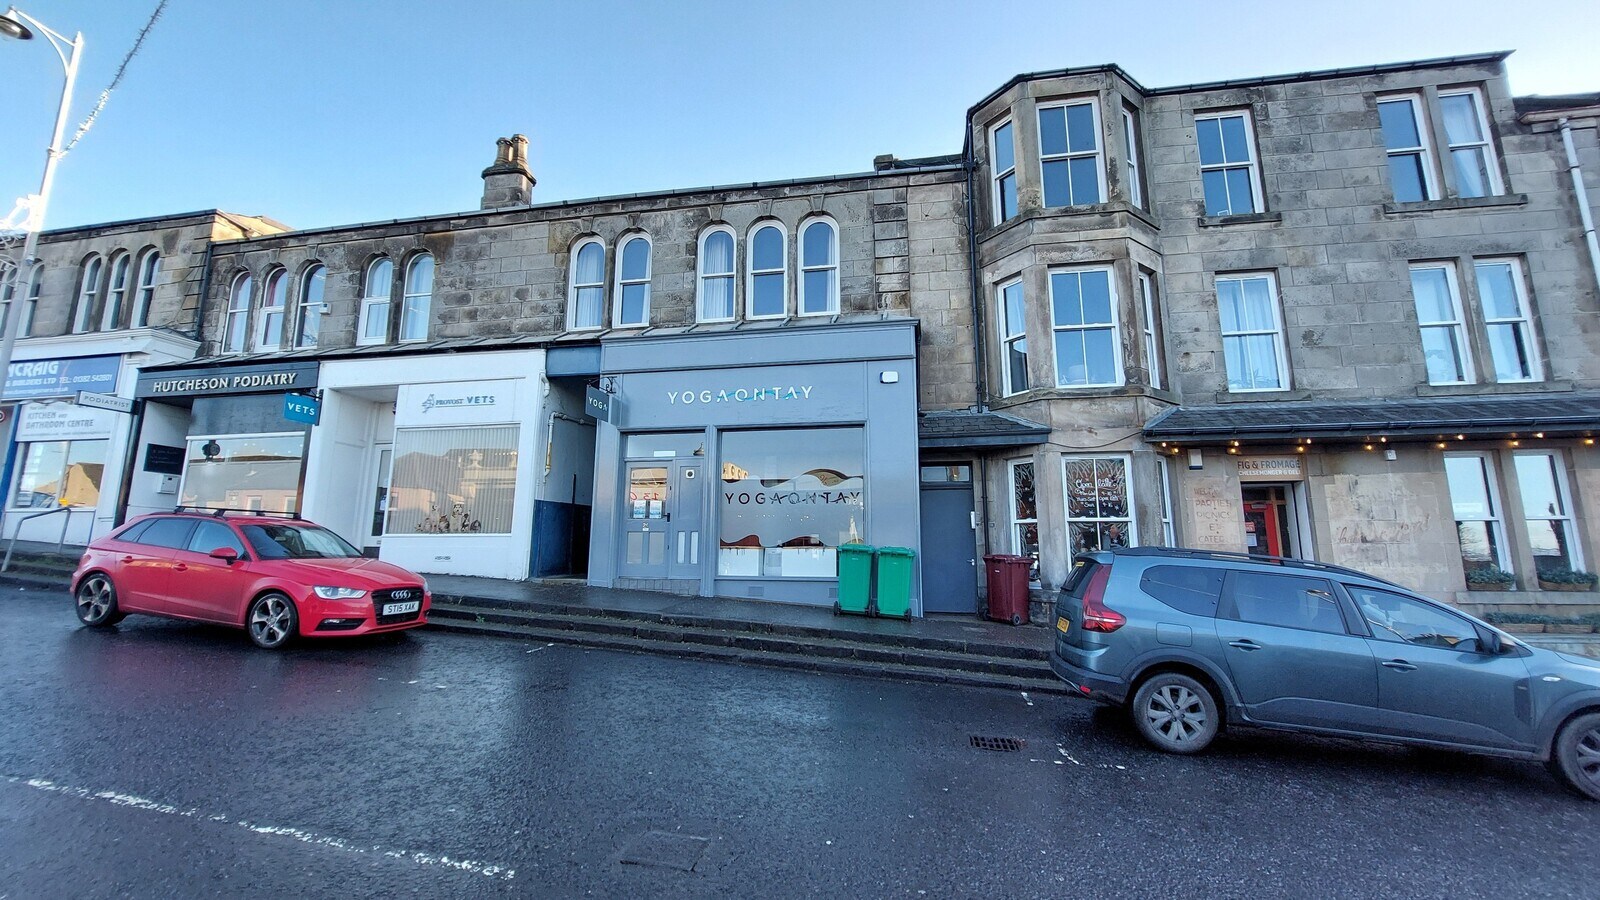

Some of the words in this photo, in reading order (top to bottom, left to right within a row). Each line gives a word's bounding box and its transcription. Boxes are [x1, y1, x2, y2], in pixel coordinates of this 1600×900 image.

[153, 378, 229, 393] HUTCHESON
[233, 373, 297, 388] PODIATRY
[84, 395, 130, 408] PODIATRIST
[466, 395, 496, 404] VETS
[588, 396, 609, 412] YOGA
[287, 402, 316, 416] VETS
[27, 411, 56, 419] KITCHEN
[25, 420, 65, 430] BATHROOM
[66, 419, 95, 428] CENTRE
[1237, 460, 1251, 470] FIG
[1252, 460, 1259, 469] &
[1260, 459, 1301, 469] FROMAGE
[388, 604, 403, 613] ST15
[404, 602, 417, 611] XAK
